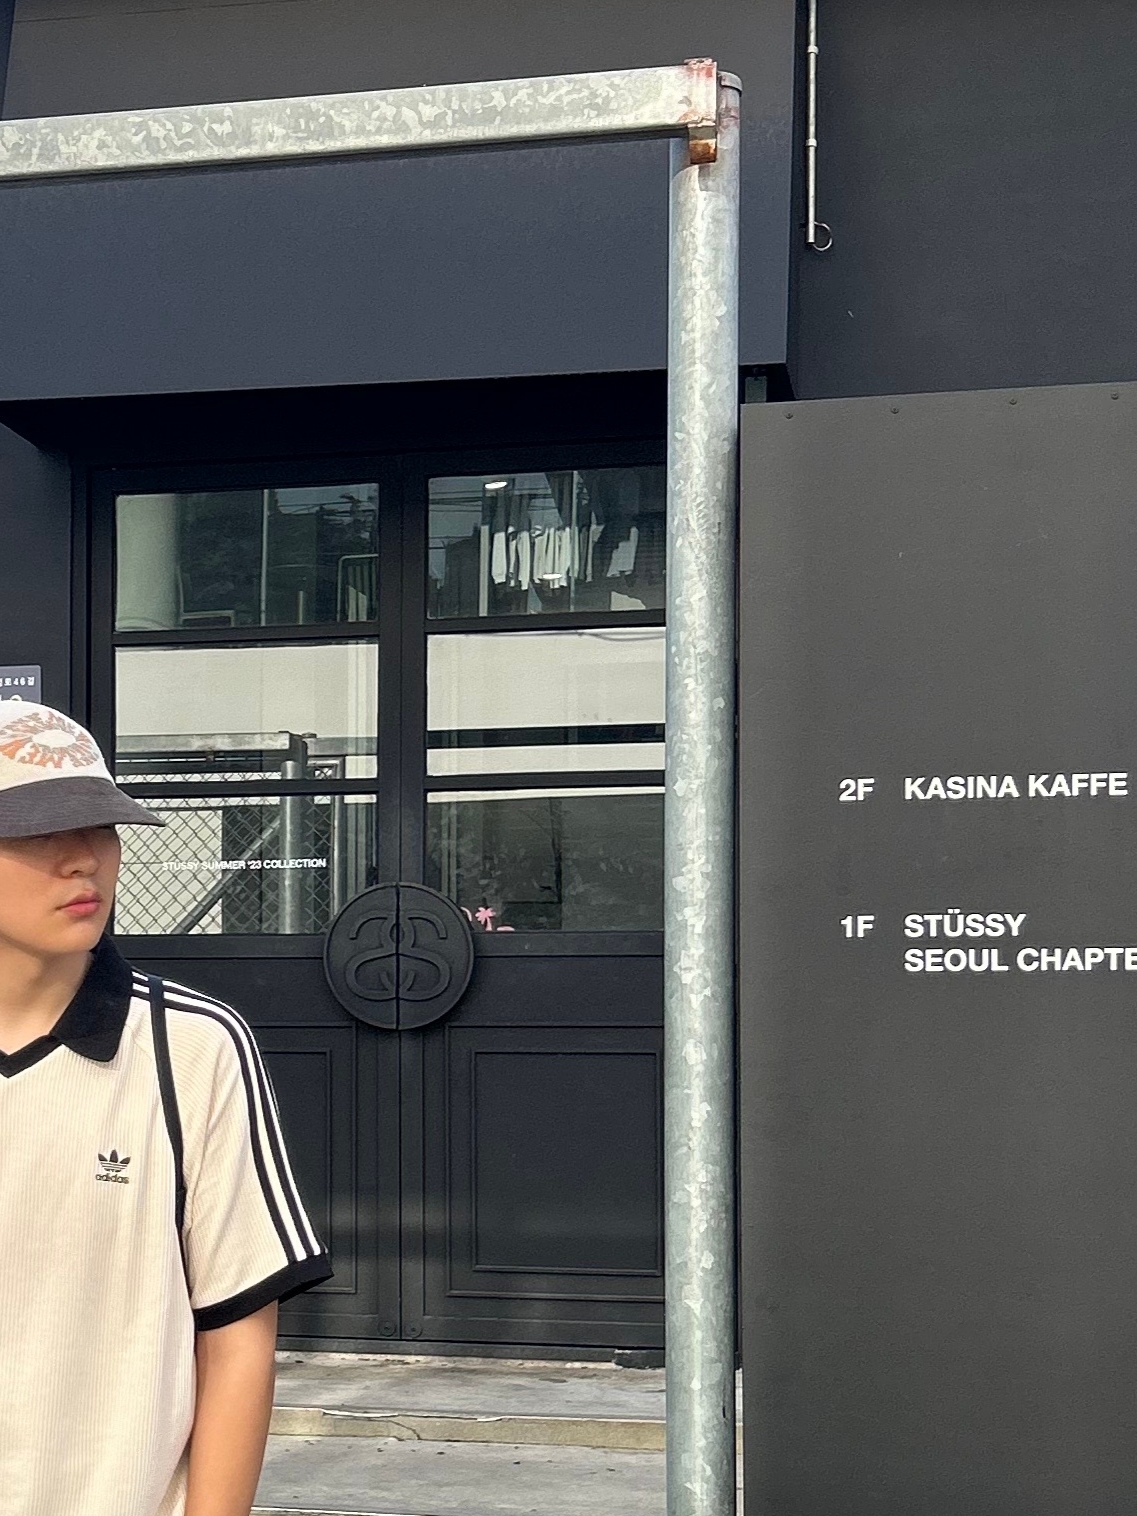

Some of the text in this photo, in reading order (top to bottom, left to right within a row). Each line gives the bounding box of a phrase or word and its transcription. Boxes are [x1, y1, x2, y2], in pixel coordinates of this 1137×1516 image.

[838, 773, 1129, 802] 2F KASINA KAFFE
[200, 860, 246, 870] SUMMER
[262, 858, 327, 870] COLLECTION
[840, 909, 1027, 938] 1F STÜSSY
[904, 947, 1137, 972] SEOUL CHAPTE
[95, 1173, 129, 1184] adidas
